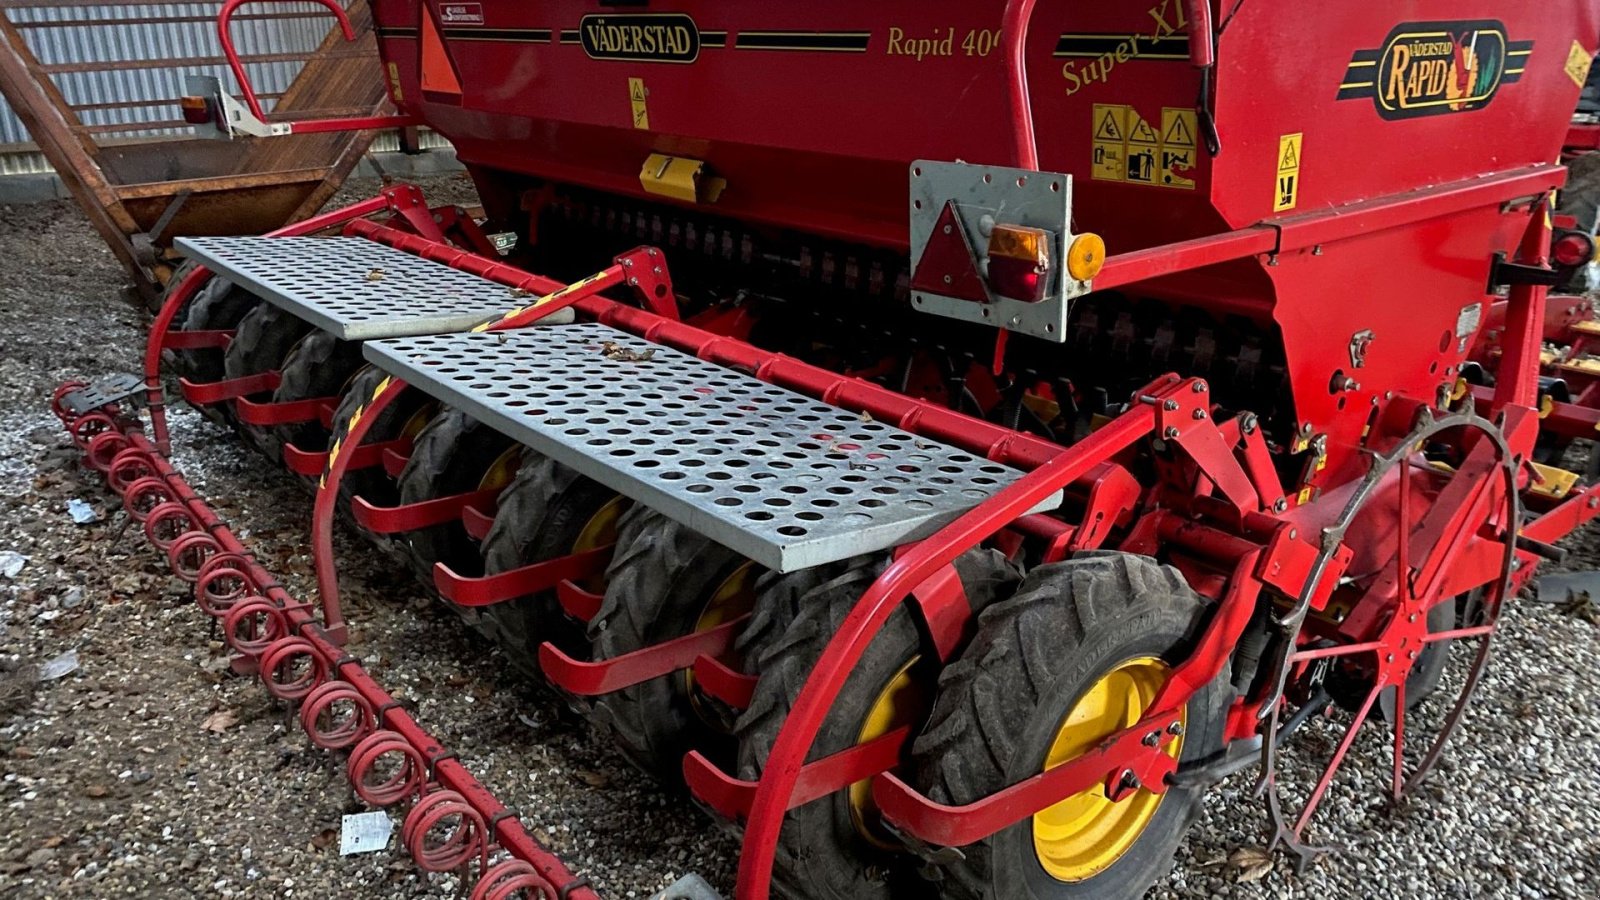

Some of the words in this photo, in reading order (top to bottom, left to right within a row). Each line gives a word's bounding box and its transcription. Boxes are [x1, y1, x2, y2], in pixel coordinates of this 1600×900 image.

[587, 19, 691, 55] VÄDERSTAD
[886, 27, 955, 62] Rapid
[961, 29, 1002, 57] 40
[1409, 40, 1453, 57] VÄDERSTAD
[1062, 33, 1140, 96] Super
[1386, 44, 1448, 108] RAPID
